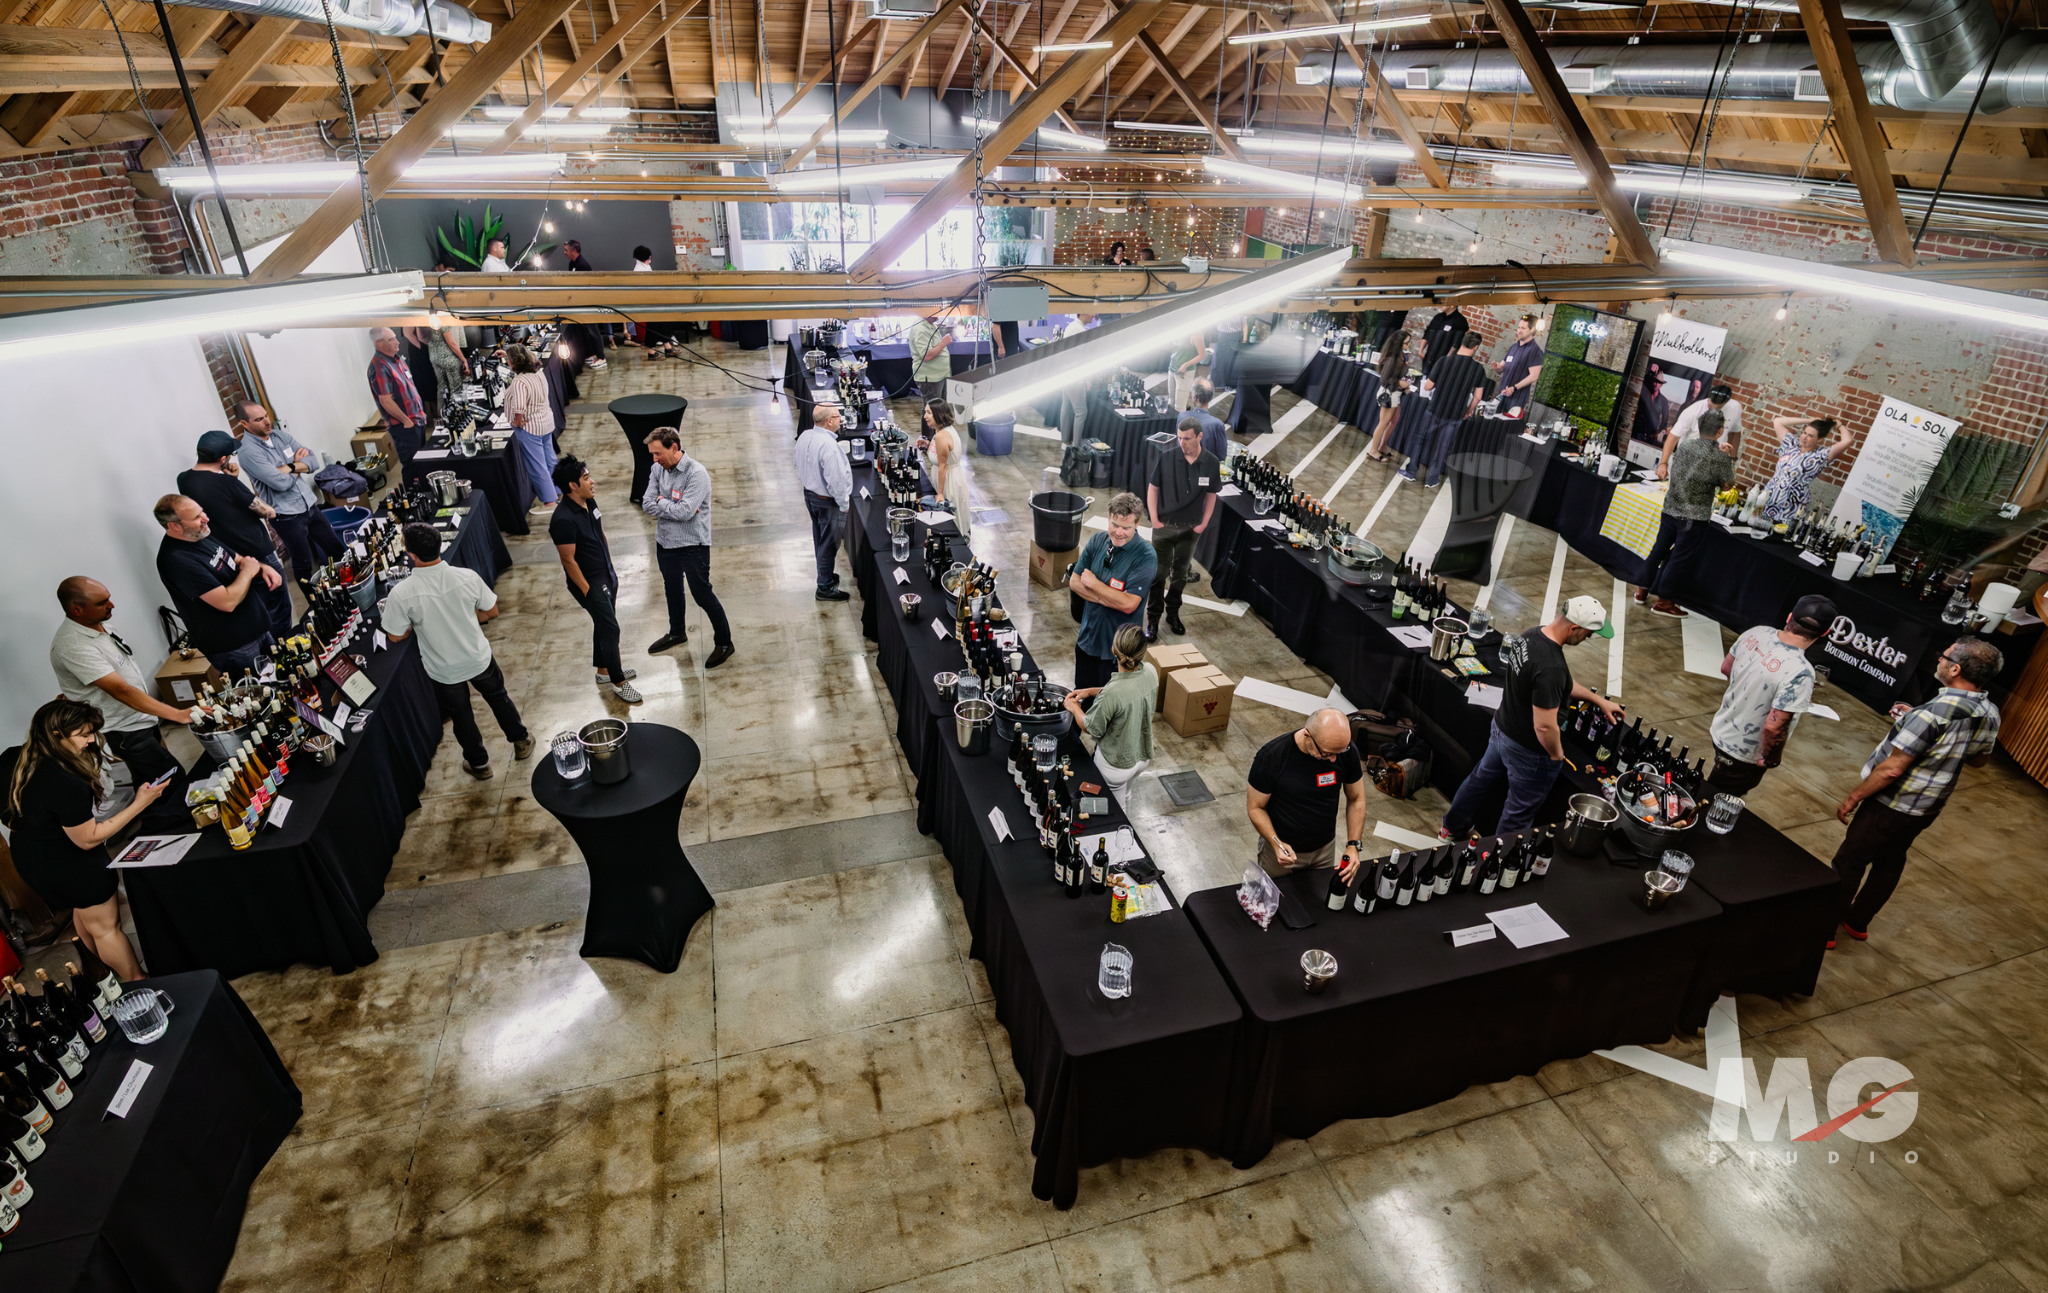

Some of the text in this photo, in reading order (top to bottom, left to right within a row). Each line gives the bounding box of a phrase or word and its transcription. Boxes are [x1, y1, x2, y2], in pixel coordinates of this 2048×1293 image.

[1653, 331, 1722, 363] Mulholland
[1884, 407, 1908, 423] OLA
[1922, 420, 1946, 438] SOL
[1827, 615, 1907, 669] Dexter
